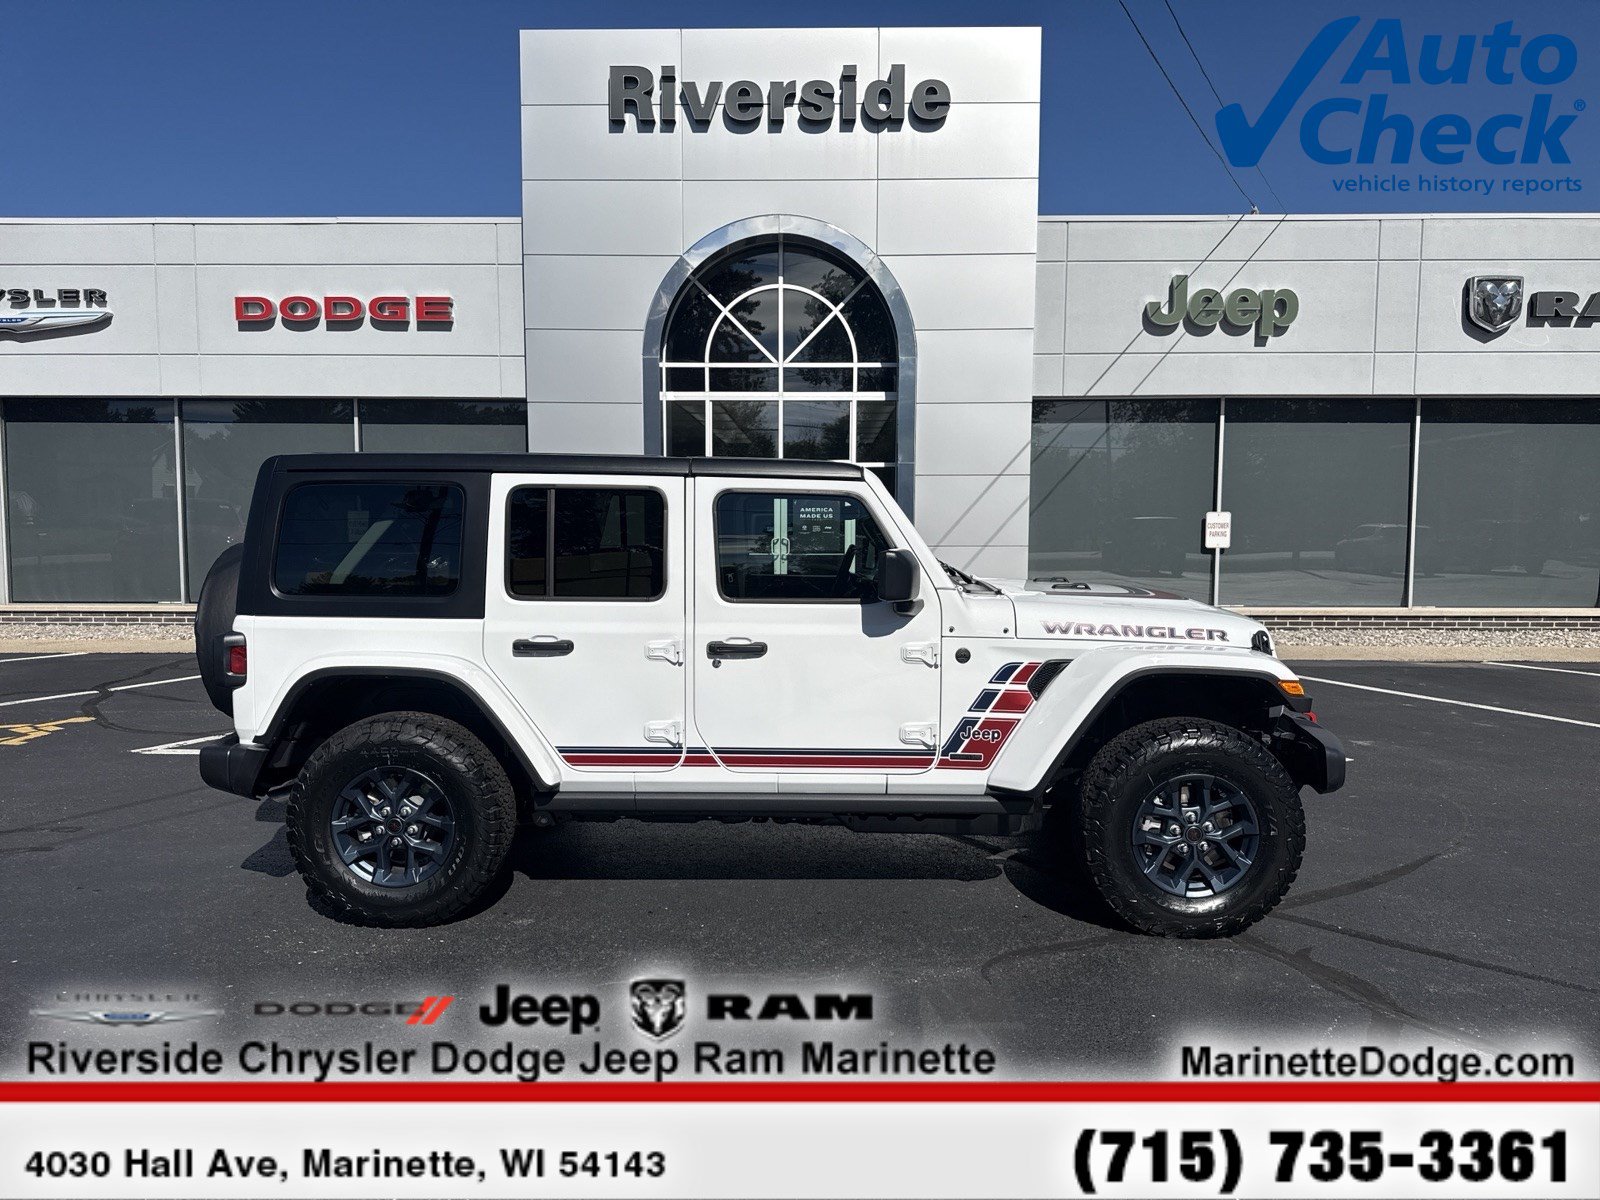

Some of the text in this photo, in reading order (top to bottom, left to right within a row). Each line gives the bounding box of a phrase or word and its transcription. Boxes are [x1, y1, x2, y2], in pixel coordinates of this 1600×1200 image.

[608, 64, 951, 122] Riverside
[234, 295, 454, 322] DODGE
[1147, 274, 1299, 337] Jeep
[1039, 620, 1230, 642] WRANGLER
[960, 725, 1002, 743] Jeep
